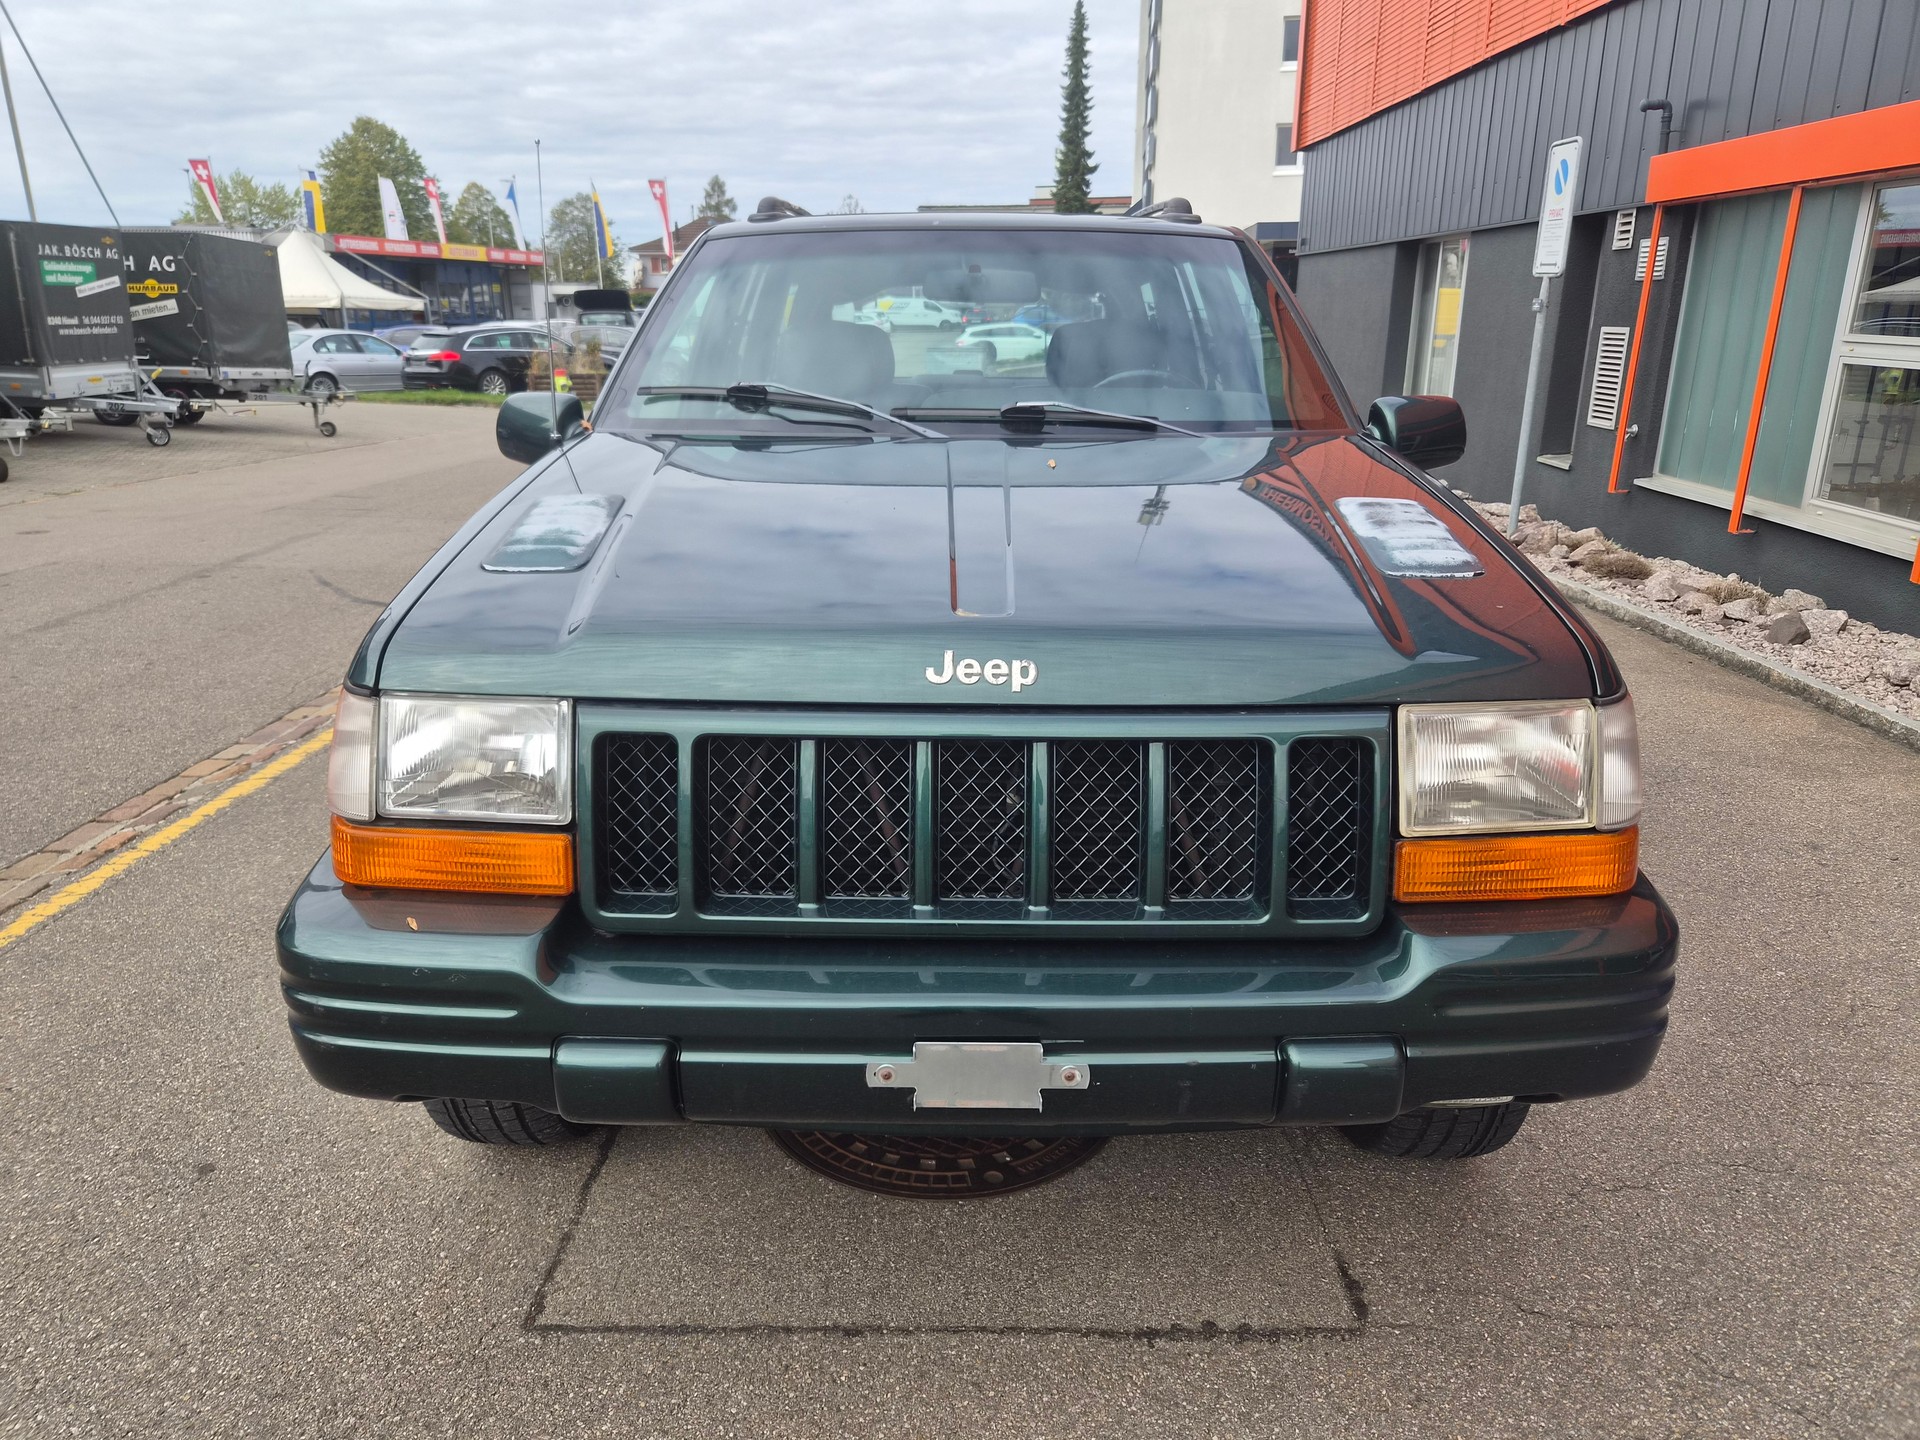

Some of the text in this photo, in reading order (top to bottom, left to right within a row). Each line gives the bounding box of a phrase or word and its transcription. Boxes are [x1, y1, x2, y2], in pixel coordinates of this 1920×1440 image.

[38, 243, 119, 260] JAK. BÖSCH AG
[149, 255, 176, 272] AG
[128, 284, 176, 293] HUMBAUR
[108, 402, 126, 413] 202
[925, 650, 1038, 693] Jeep
